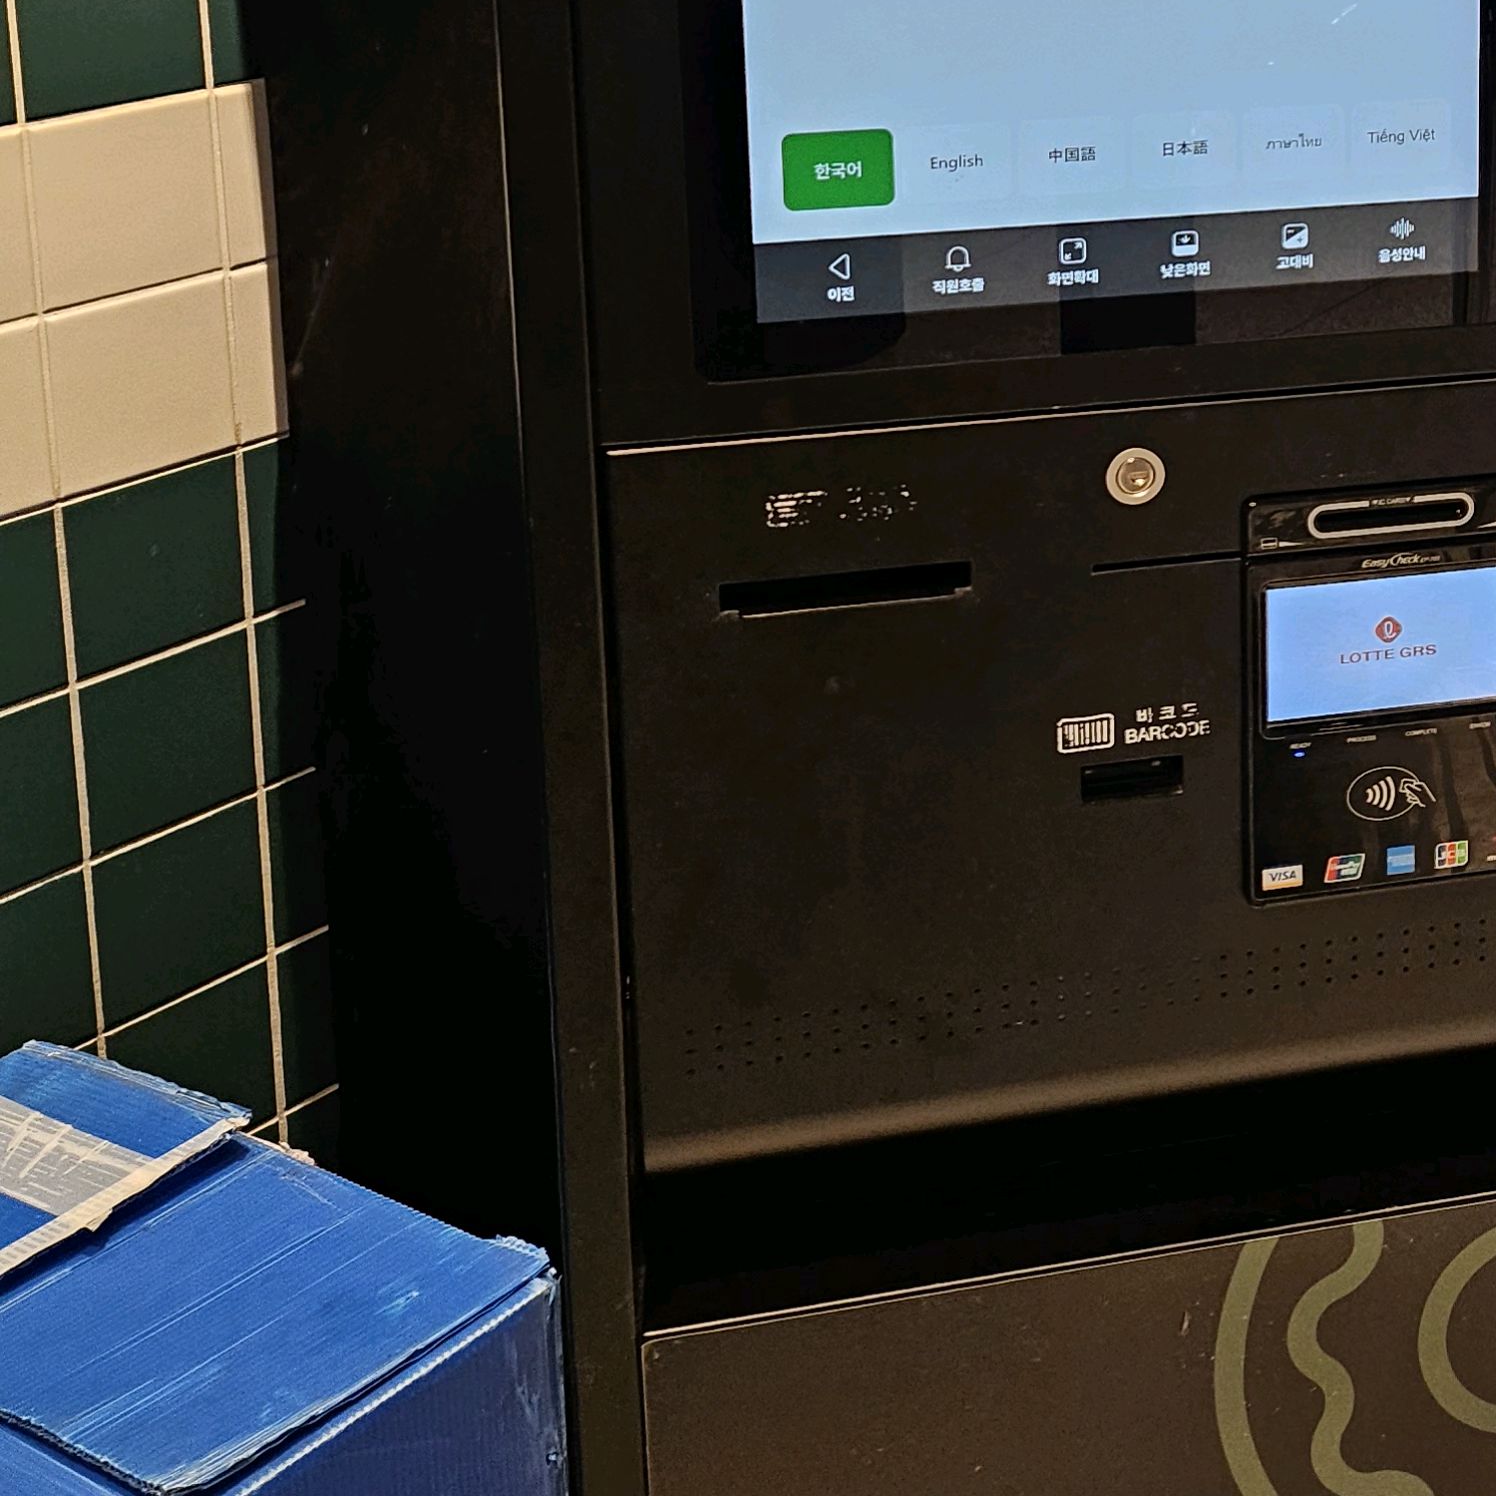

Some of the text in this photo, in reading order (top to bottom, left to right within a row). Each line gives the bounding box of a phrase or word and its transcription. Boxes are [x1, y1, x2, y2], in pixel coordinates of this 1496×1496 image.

[1162, 138, 1210, 156] 日本語
[1265, 132, 1323, 151] ภาษาไทย
[930, 153, 984, 171] English
[1048, 145, 1097, 163] 中国語
[814, 159, 863, 181] 한국어
[1276, 253, 1315, 271] 고대비
[1379, 245, 1427, 263] 음성안내
[1047, 269, 1100, 287] 화면확대
[1160, 260, 1212, 278] 낮은화면
[827, 285, 855, 303] 이전
[932, 278, 985, 296] 직원호출
[1340, 644, 1437, 665] LOTTE GRS
[1124, 719, 1211, 744] BARCODE
[1267, 869, 1297, 883] VISA
